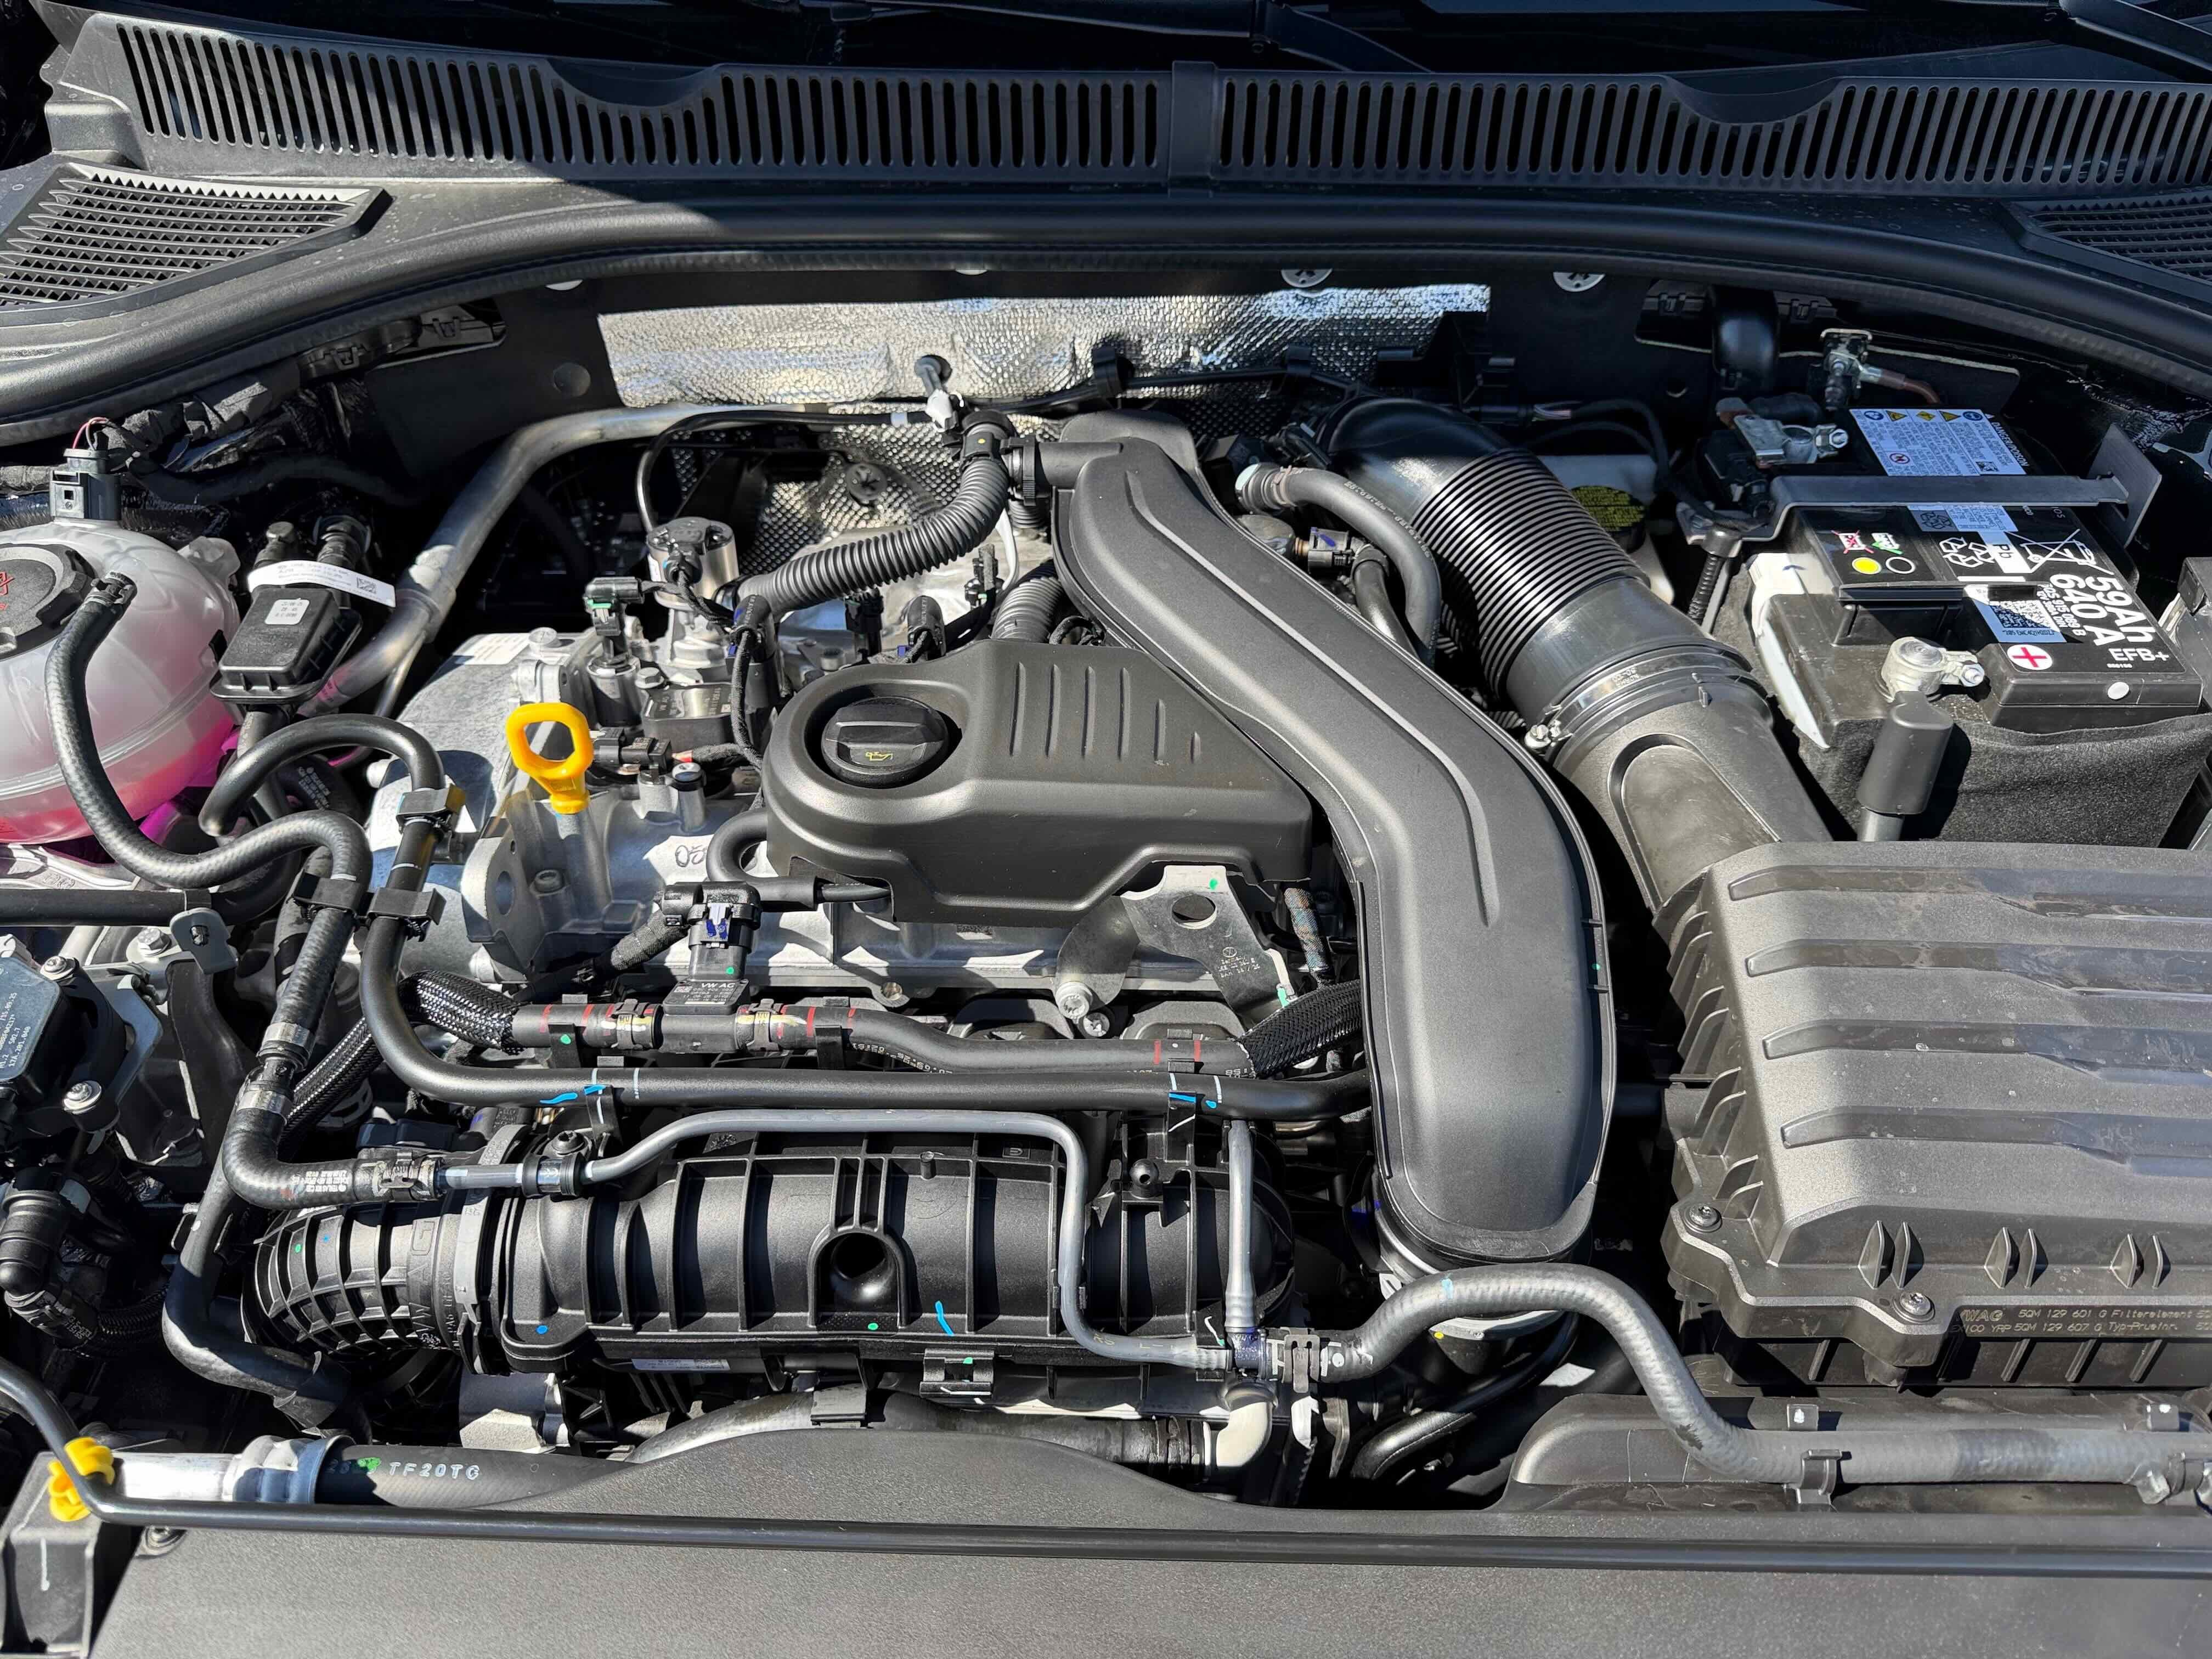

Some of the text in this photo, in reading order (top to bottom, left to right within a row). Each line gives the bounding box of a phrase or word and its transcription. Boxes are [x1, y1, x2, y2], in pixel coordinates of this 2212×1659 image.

[1995, 545, 2012, 558] Pb
[2050, 573, 2108, 619] 640
[2083, 624, 2126, 646] A
[2052, 599, 2070, 613] 915
[2085, 576, 2156, 642] 59Ah
[2107, 648, 2170, 662] EFB+
[2047, 1309, 2068, 1318] 129
[2072, 1309, 2092, 1318] 601
[2098, 1310, 2107, 1318] G
[2111, 1309, 2193, 1319] Filterelement
[2042, 1323, 2063, 1332] 129
[2067, 1323, 2090, 1332] 607
[2094, 1323, 2103, 1332] G
[388, 1461, 480, 1480] TF20TG
